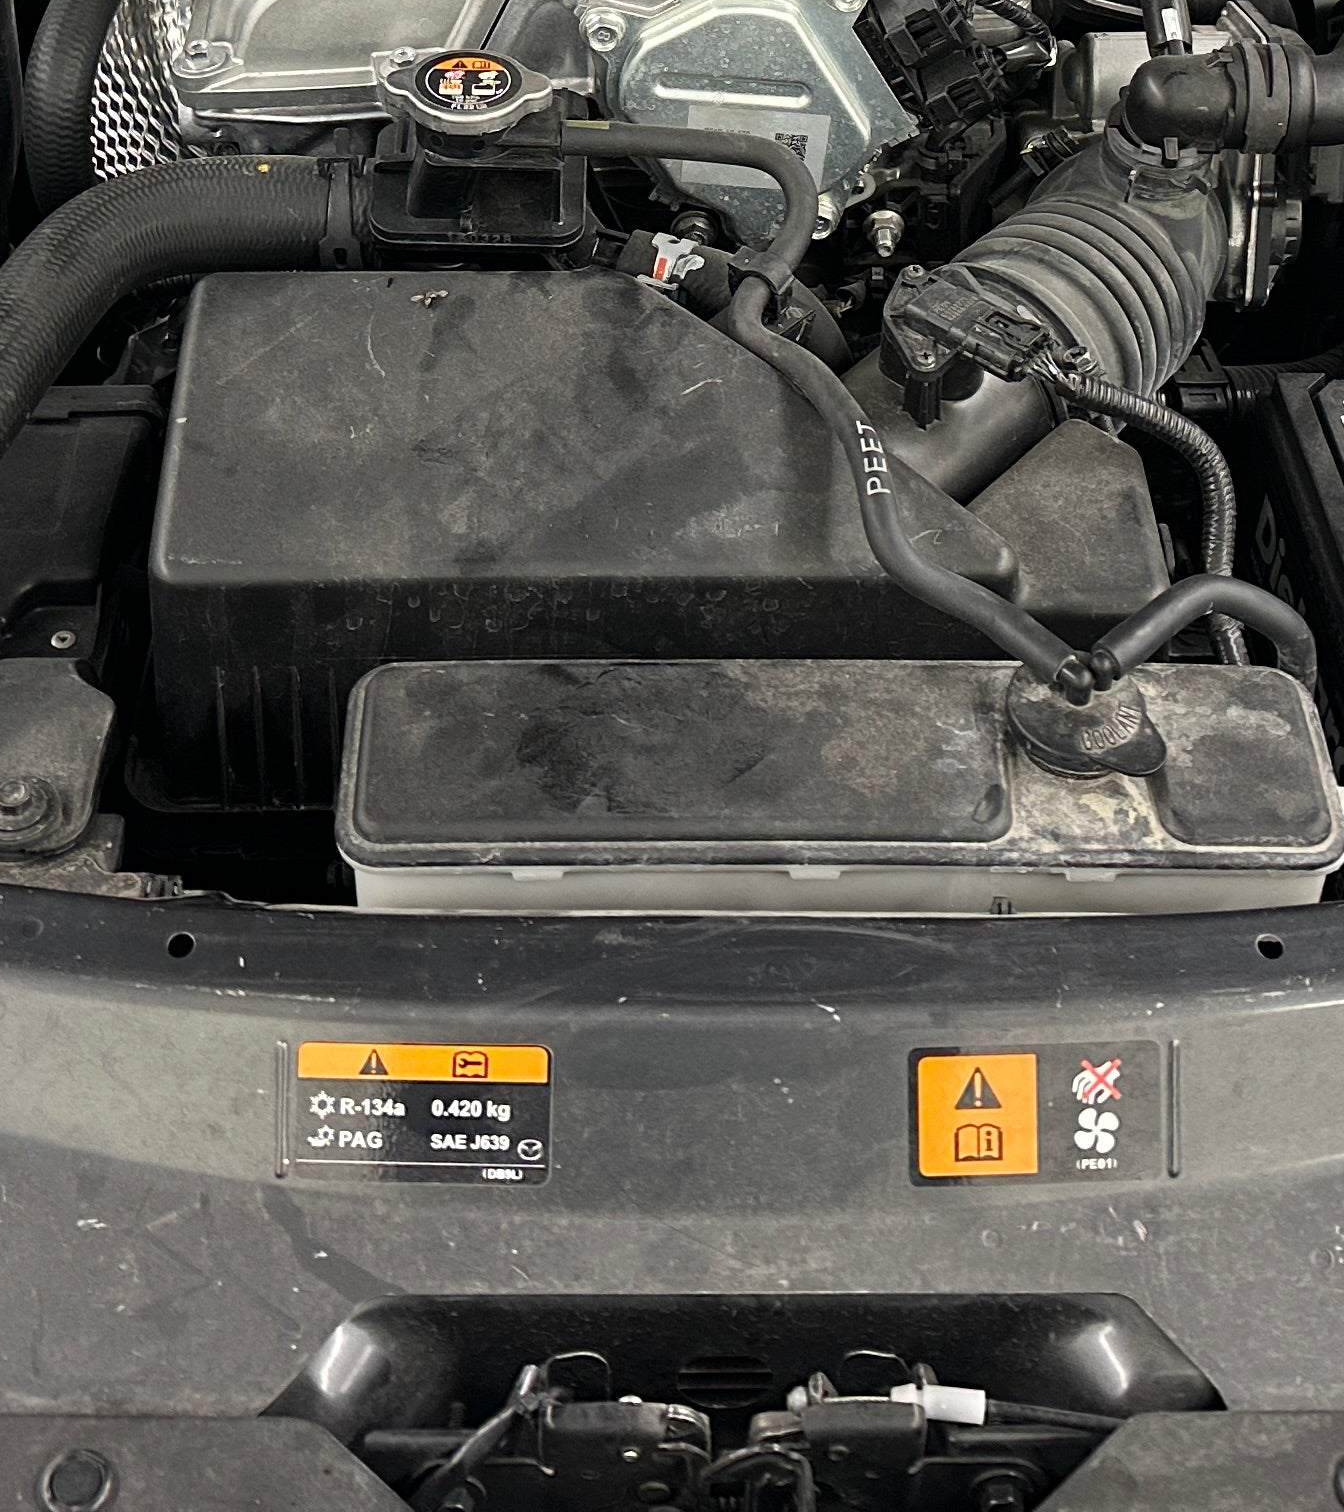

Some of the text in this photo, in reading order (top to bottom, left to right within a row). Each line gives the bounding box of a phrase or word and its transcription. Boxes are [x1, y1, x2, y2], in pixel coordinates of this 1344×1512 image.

[339, 1097, 511, 1121] R-134a 0.420 kg
[338, 1130, 510, 1150] PAG SAE J639
